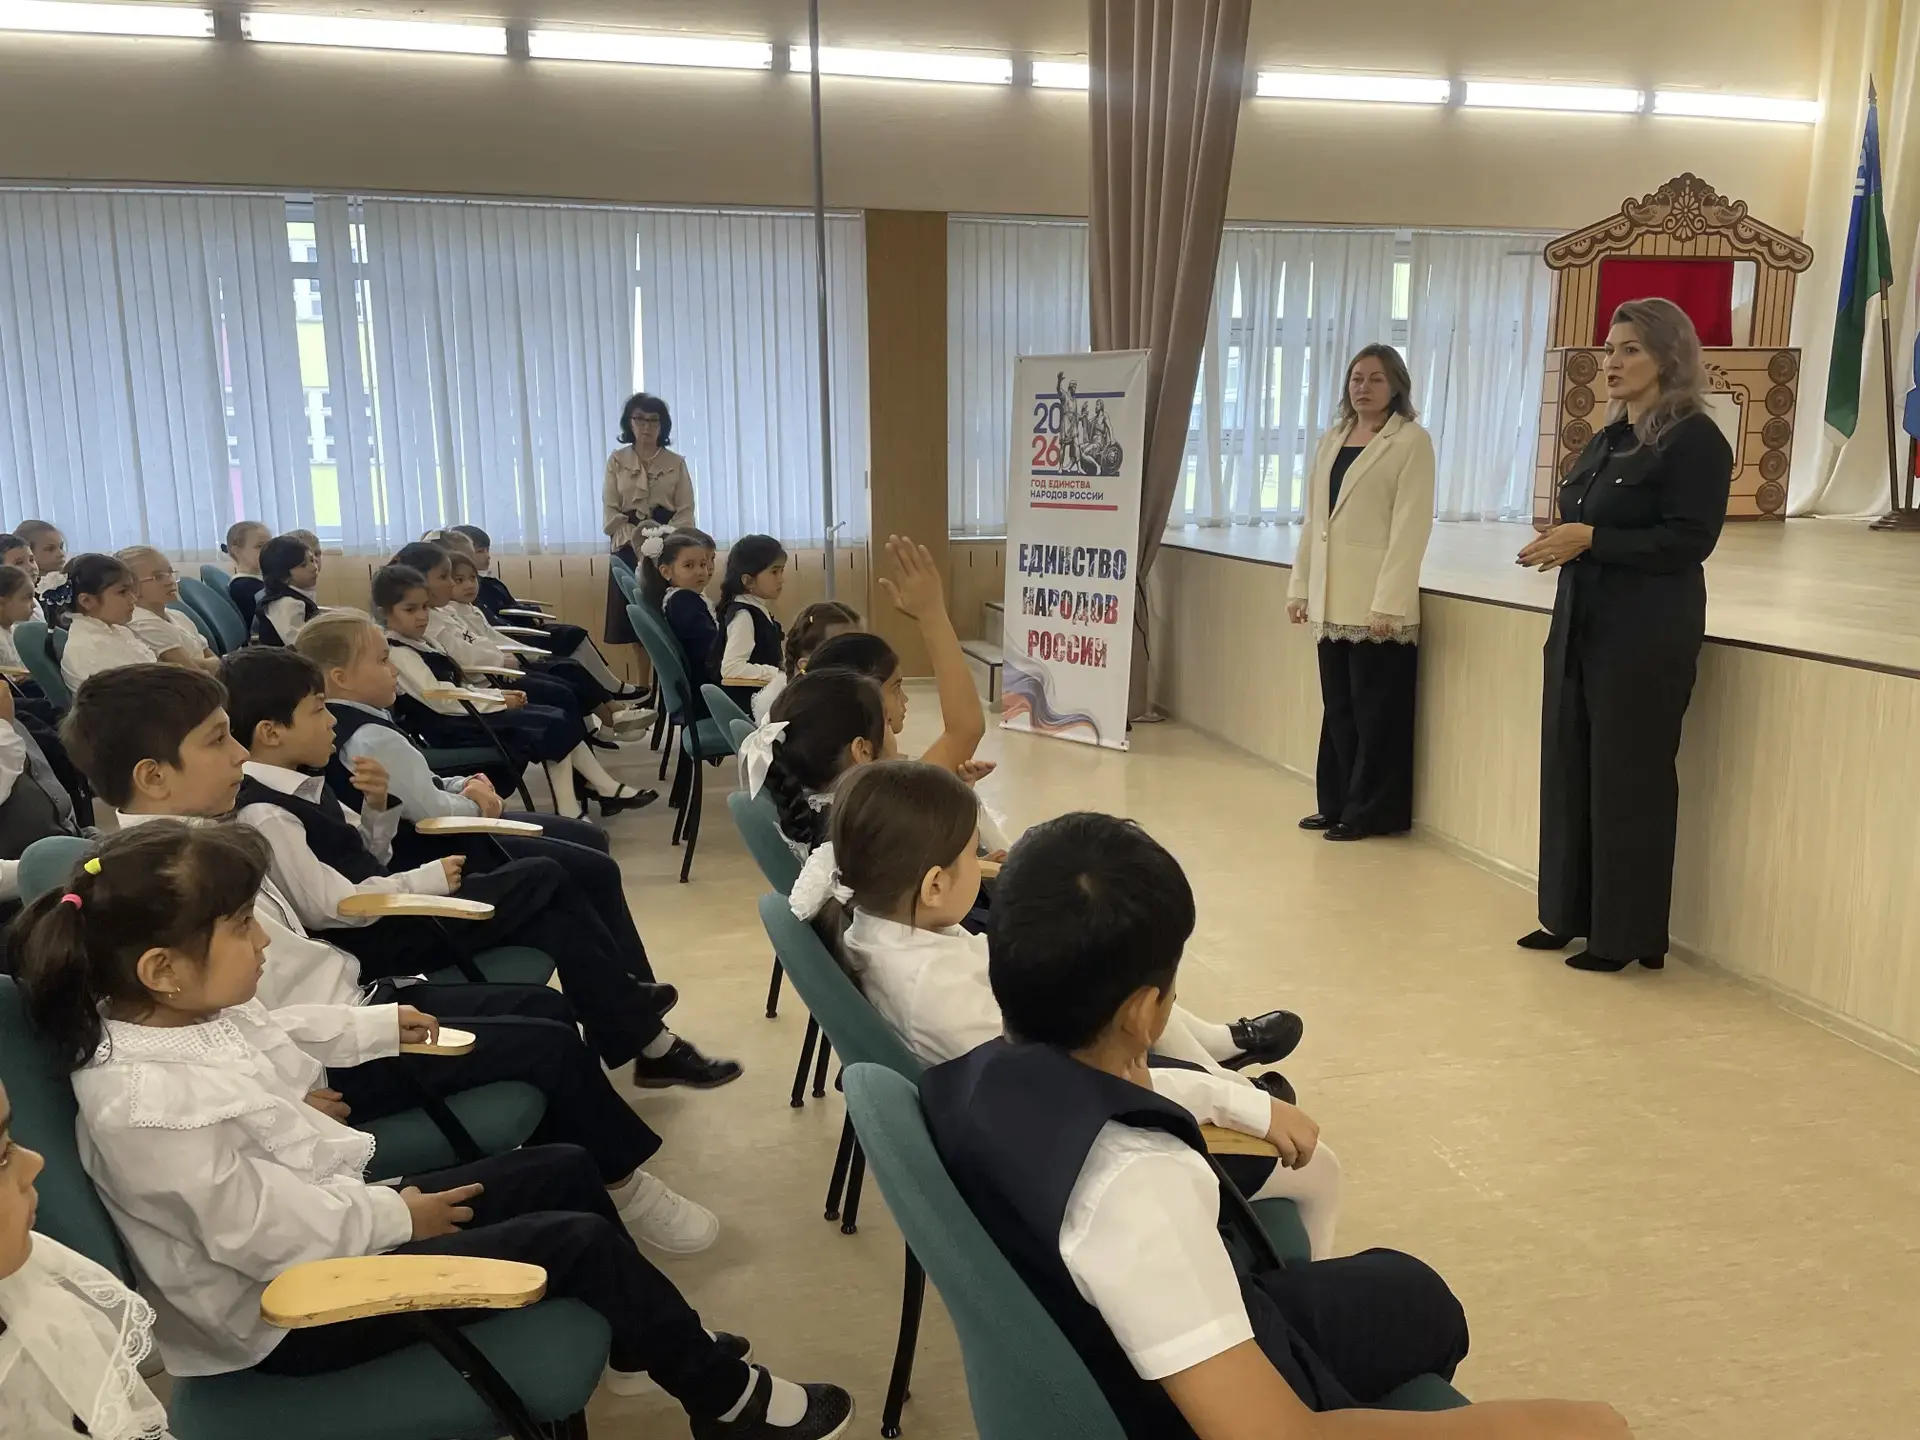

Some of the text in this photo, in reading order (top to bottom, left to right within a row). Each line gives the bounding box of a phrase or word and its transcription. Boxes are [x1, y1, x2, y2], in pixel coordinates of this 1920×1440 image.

[1033, 403, 1063, 434] 20
[1032, 435, 1060, 466] 26
[1030, 490, 1104, 500] НАРОДОВ РОССИИ
[1031, 479, 1090, 489] ГОД ЕДИНСТВА
[1019, 543, 1127, 581] ЕДИНСТВО
[1022, 586, 1119, 626] НАРОДОВ
